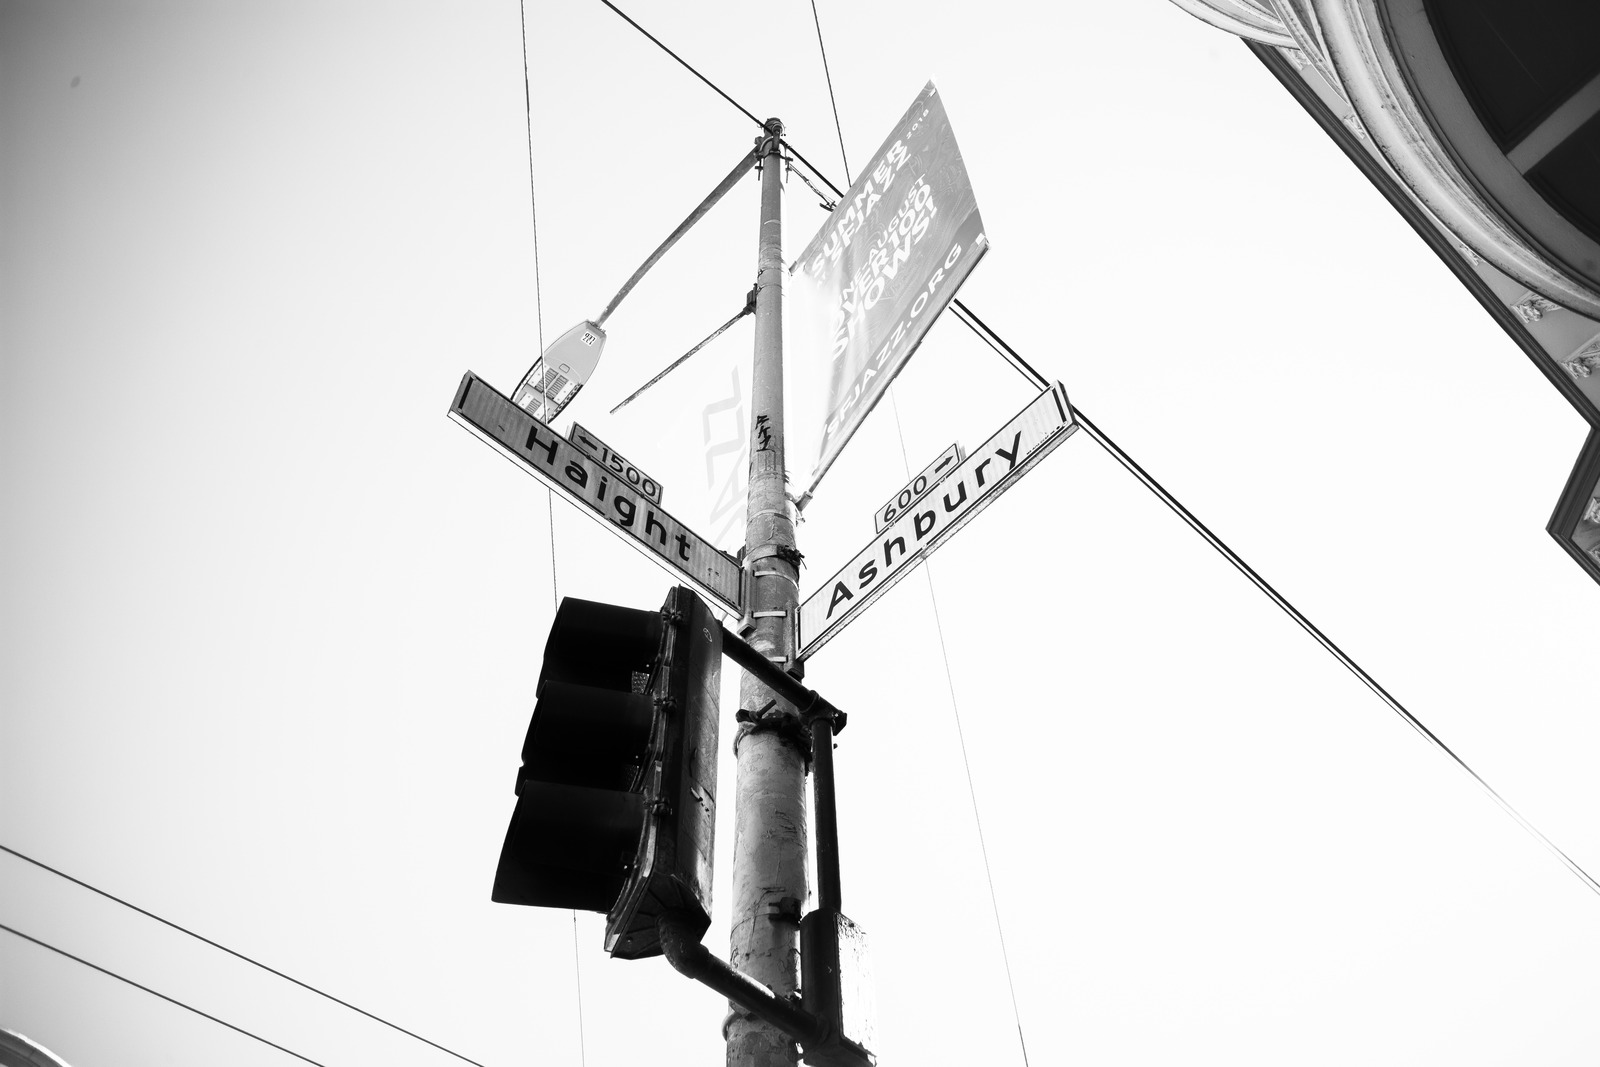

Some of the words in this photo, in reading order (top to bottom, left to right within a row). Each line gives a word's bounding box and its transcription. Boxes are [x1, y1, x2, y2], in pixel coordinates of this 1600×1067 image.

[812, 140, 903, 278] SUMMER
[906, 109, 930, 140] 2018
[830, 253, 890, 338] OVER
[888, 184, 931, 249] 100
[832, 145, 911, 268] SFJAZZ
[838, 174, 925, 309] UNE-AUGUST
[827, 243, 962, 440] SFJAZZ.ORG
[832, 196, 938, 362] SHOWS!
[525, 425, 691, 562] Haight
[602, 447, 657, 498] 1500
[826, 430, 1022, 620] Ashbury
[883, 475, 928, 523] 600
